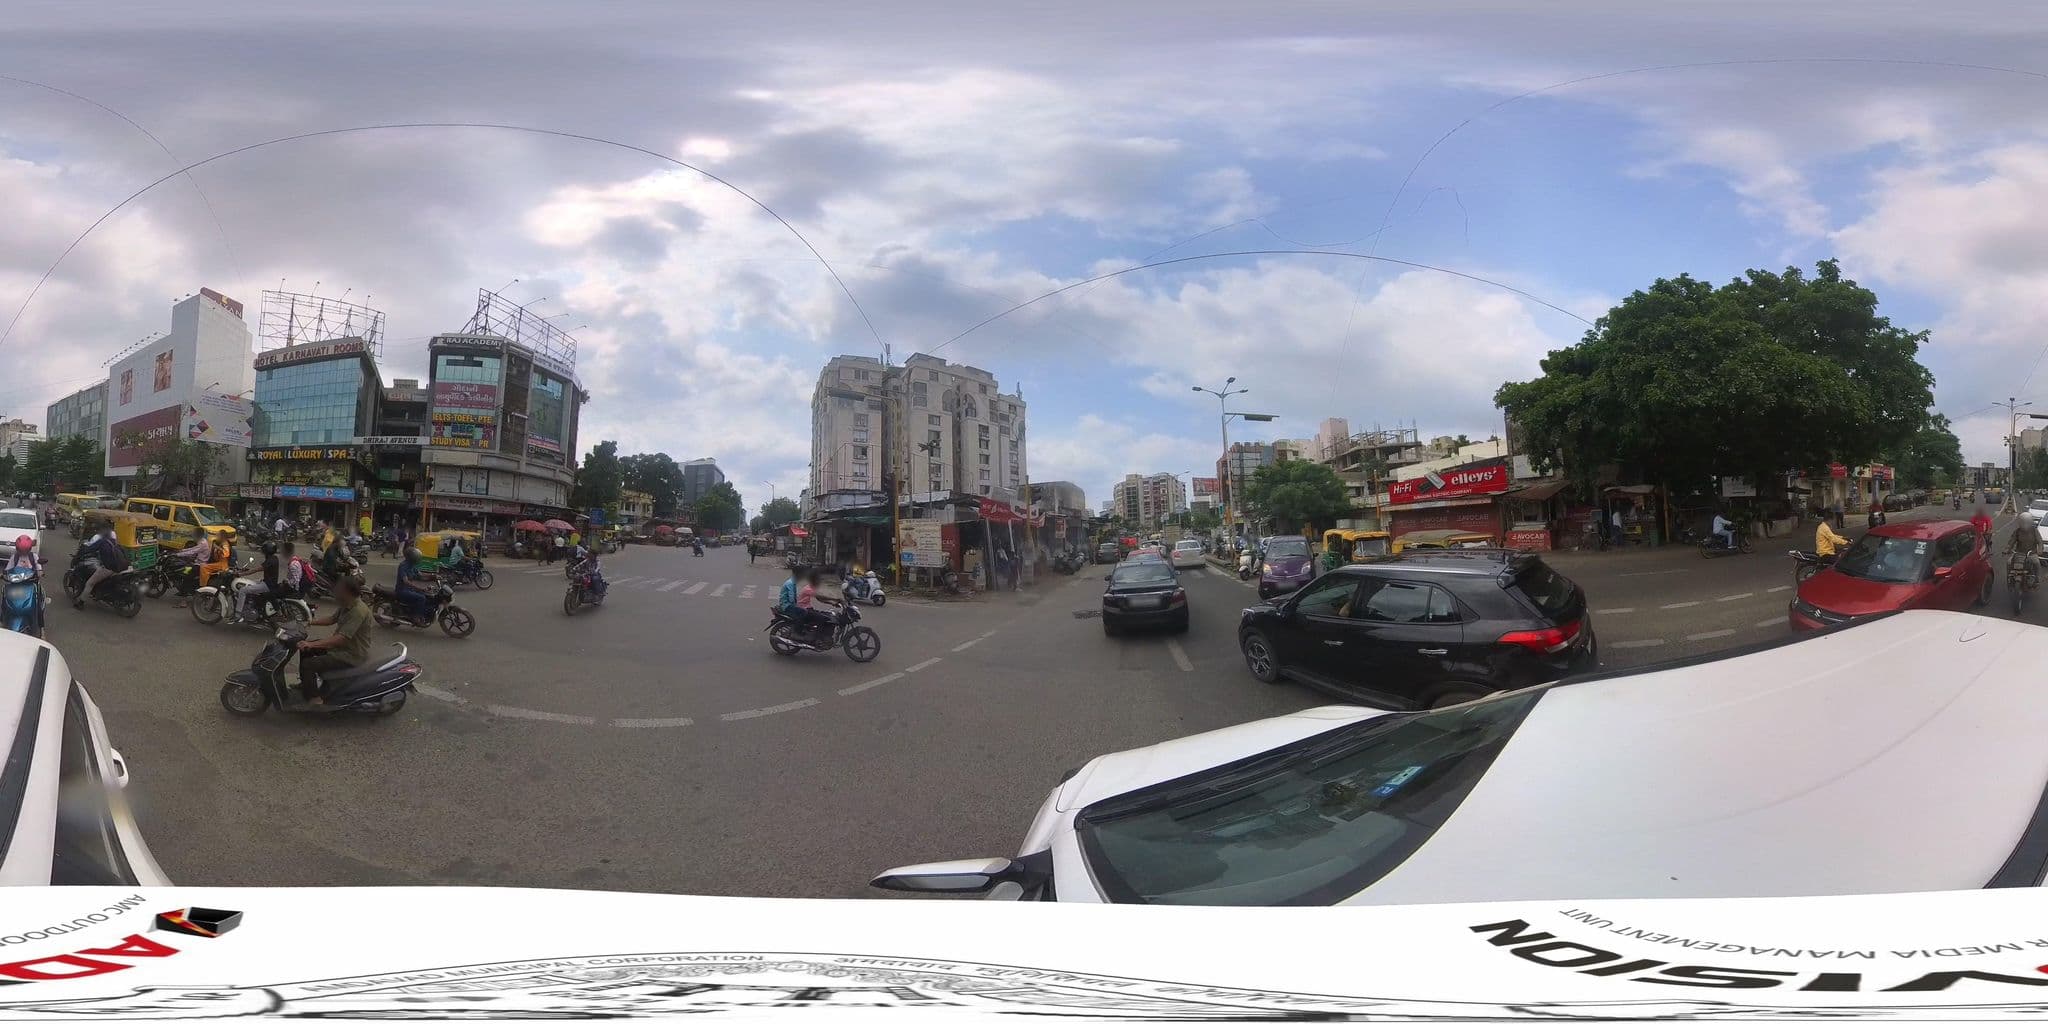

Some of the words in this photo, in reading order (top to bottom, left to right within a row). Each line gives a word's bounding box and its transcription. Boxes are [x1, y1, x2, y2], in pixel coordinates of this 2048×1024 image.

[462, 338, 502, 347] ACADEMY
[254, 354, 278, 368] HOTEL
[282, 346, 329, 362] KARNAVATI
[333, 341, 364, 354] ROOMS
[363, 437, 389, 445] DHIRAJ
[431, 437, 452, 446] STUDY
[454, 438, 471, 447] VISA
[478, 440, 489, 449] PR
[257, 450, 283, 460] ROYAL
[288, 449, 323, 459] LUXURY
[328, 450, 347, 459] SPA
